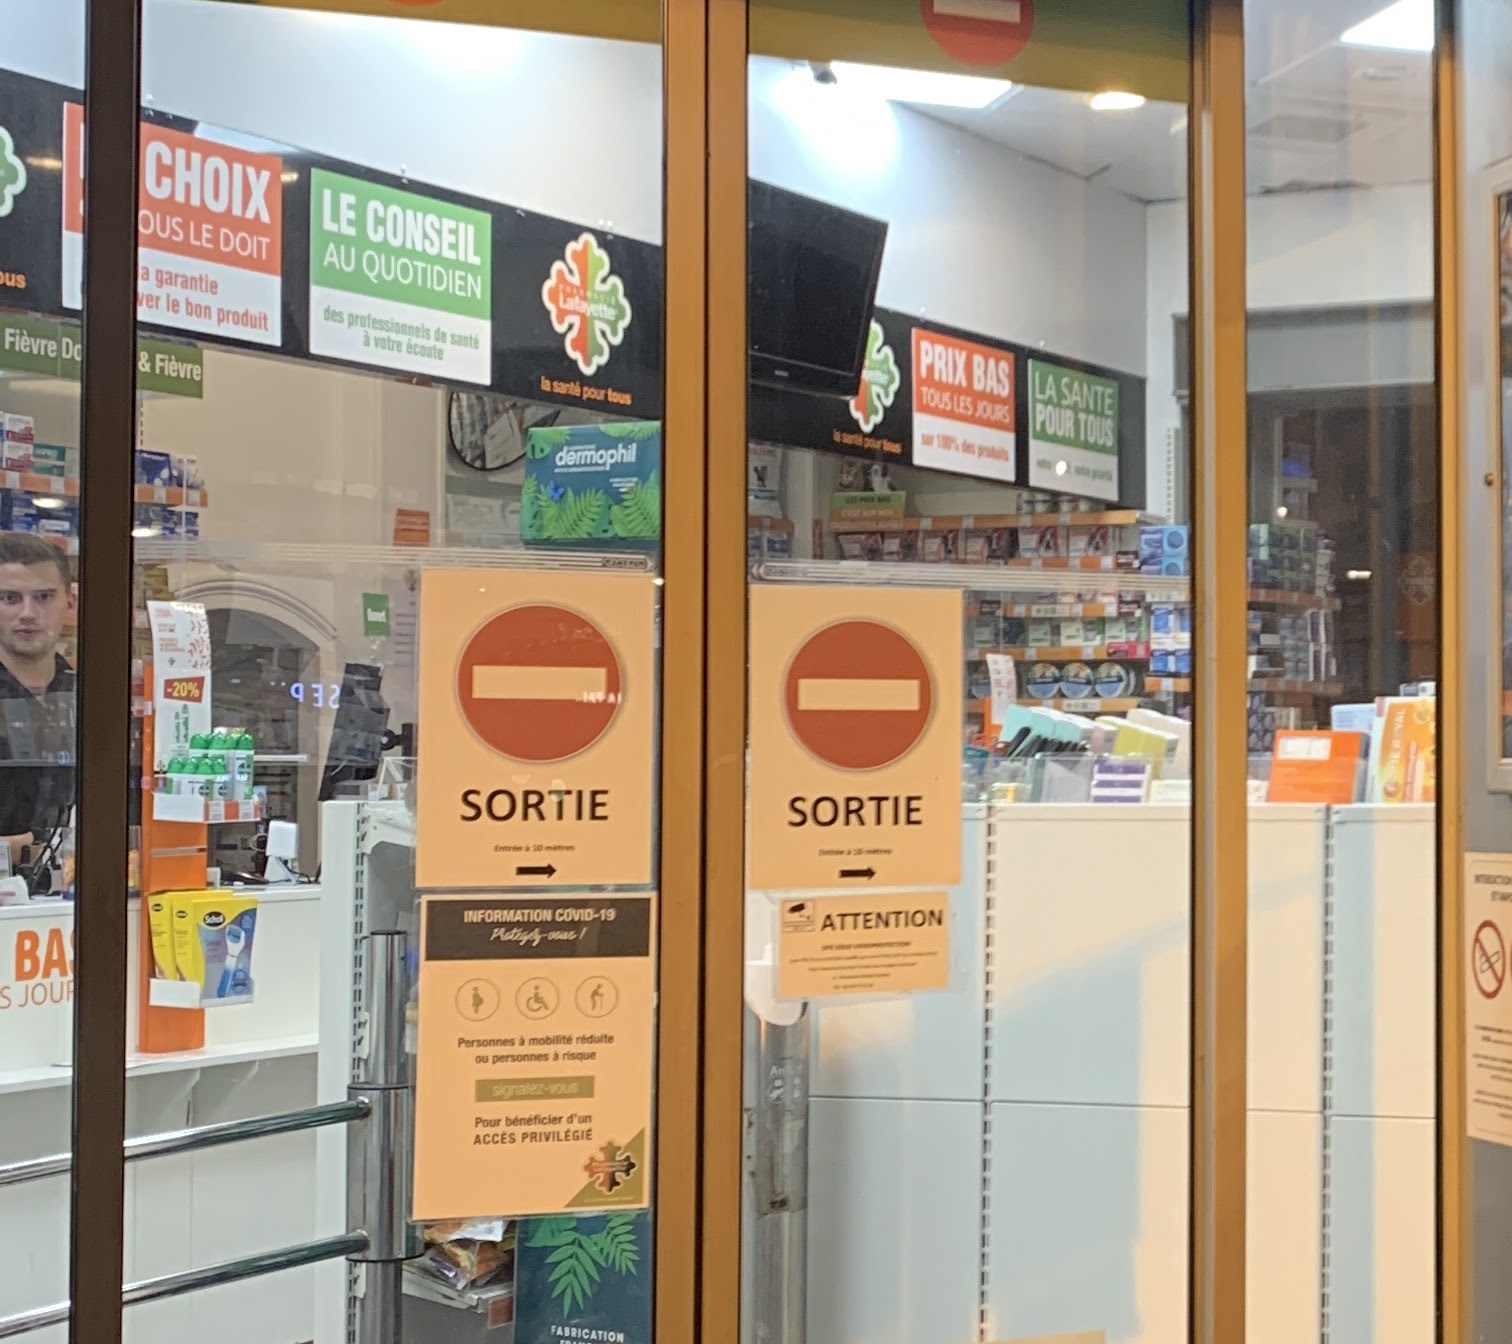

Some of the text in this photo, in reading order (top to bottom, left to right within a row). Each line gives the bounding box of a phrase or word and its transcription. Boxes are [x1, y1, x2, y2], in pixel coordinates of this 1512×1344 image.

[145, 140, 271, 224] CHOIX
[138, 208, 271, 261] OUS LE DOIT
[322, 187, 481, 267] LE CONSEIL
[155, 268, 219, 296] garantie
[323, 242, 481, 301] AU QUOTIDIEN
[166, 293, 180, 315] le
[185, 296, 212, 321] bon
[216, 302, 269, 332] produit
[558, 291, 618, 321] Lafayette
[323, 304, 480, 350] des professionnels de santé
[4, 328, 58, 359] Fièvre
[138, 351, 151, 373] &
[155, 353, 202, 382] Fièvre
[372, 334, 403, 354] votre
[405, 340, 445, 362] écoute
[920, 339, 1010, 398] PRIX BAS
[541, 376, 632, 406] la santé pour tous
[1035, 371, 1058, 403] LA
[920, 386, 1010, 425] TOUS LES JOURS
[1035, 402, 1114, 448] POUR TOUS
[555, 442, 637, 471] dermophil
[166, 681, 200, 698] -20%
[460, 788, 610, 822] SORTIE
[787, 794, 924, 828] SORTIE
[204, 914, 225, 924] Scholl
[464, 907, 617, 923] INFORMATION COVID-19
[820, 908, 944, 932] ATTENTION
[15, 927, 75, 982] BA
[458, 1033, 615, 1049] Personnes à mobilité réduite
[475, 1055, 489, 1064] ou
[492, 1053, 549, 1066] personnes
[562, 1051, 597, 1063] risque
[492, 1081, 578, 1099] signalez-vous
[475, 1116, 501, 1128] Pour
[505, 1114, 563, 1127] bénéficier
[473, 1127, 593, 1146] ACCÈS PRIVILÉGIÉ
[550, 1324, 624, 1343] FABRICATION
